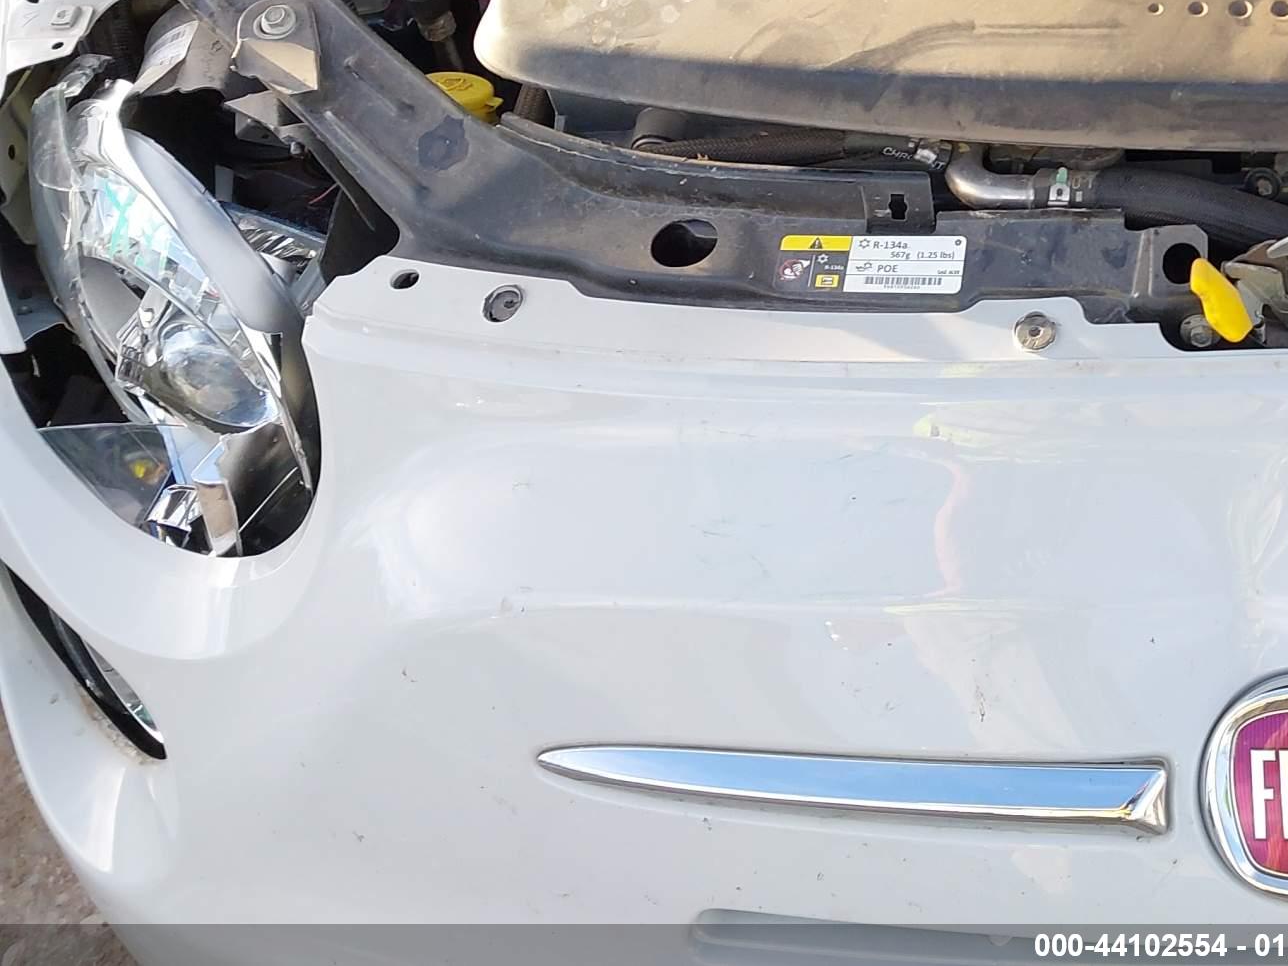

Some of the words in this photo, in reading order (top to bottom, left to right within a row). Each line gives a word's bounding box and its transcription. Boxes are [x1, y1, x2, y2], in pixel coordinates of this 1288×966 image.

[873, 240, 908, 250] R-134a
[890, 251, 911, 260] 567g
[916, 251, 938, 259] (1.25
[940, 251, 955, 260] lbs)
[876, 264, 899, 273] POE
